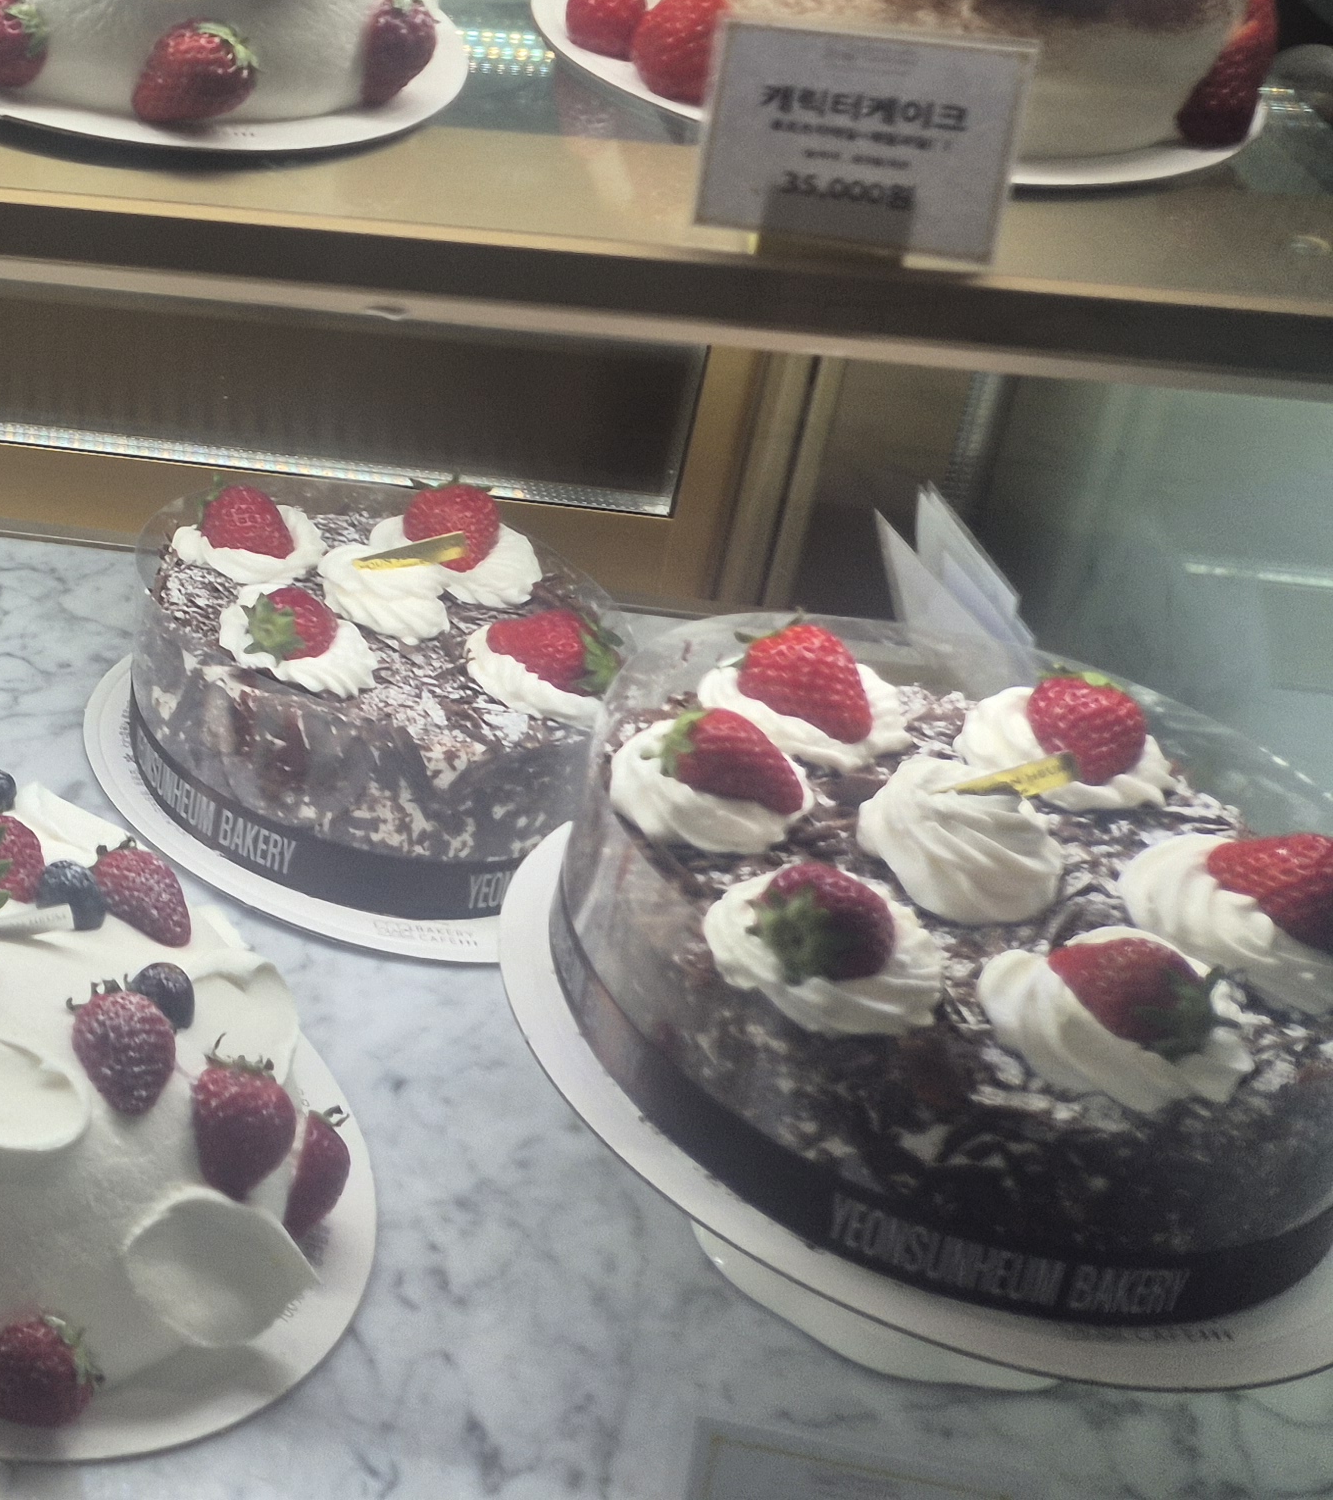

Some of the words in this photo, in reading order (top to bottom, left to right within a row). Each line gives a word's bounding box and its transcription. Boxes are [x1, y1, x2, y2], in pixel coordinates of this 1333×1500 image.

[758, 83, 969, 134] 캐릭터케이크
[218, 807, 297, 875] BAKERY
[828, 1192, 1067, 1311] YEONSUNHEUM
[1068, 1258, 1190, 1318] BAKERY
